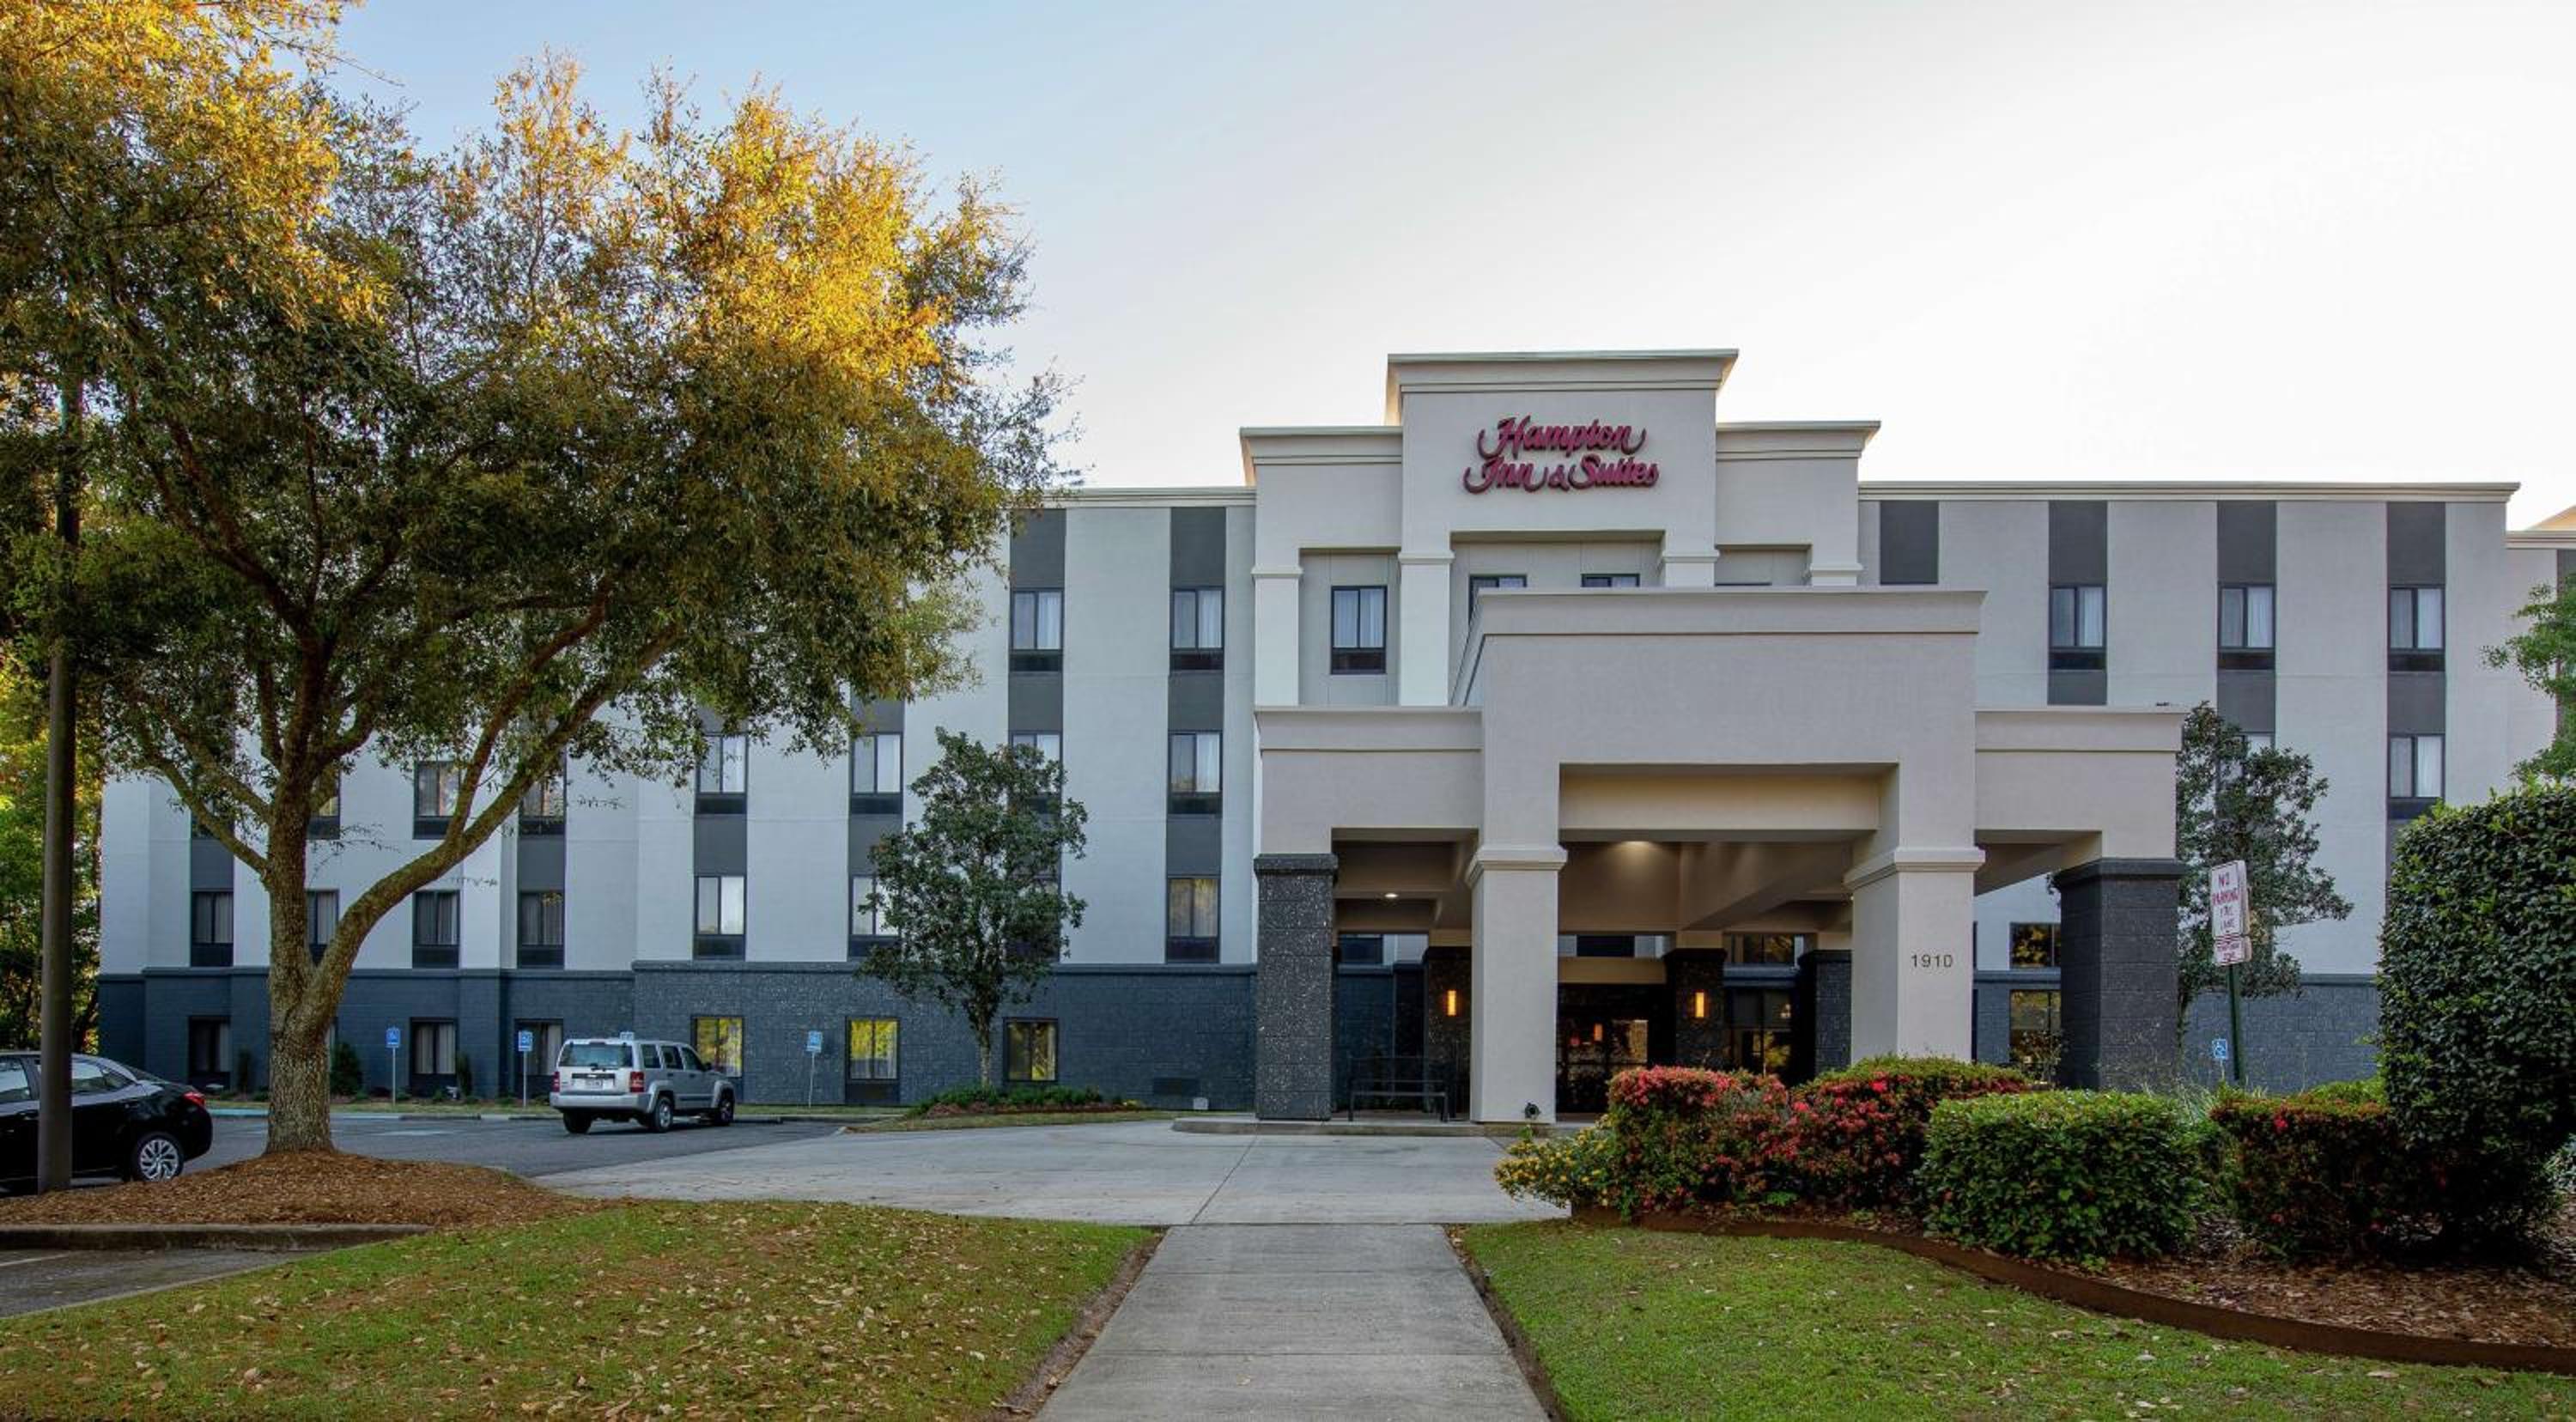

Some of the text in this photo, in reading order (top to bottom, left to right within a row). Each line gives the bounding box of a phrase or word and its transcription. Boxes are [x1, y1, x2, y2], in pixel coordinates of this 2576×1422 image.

[1477, 415, 1647, 460] Hampton
[1463, 453, 1660, 495] Inn & Suites
[2211, 887, 2239, 905] PARKING
[1911, 954, 1953, 968] 1910
